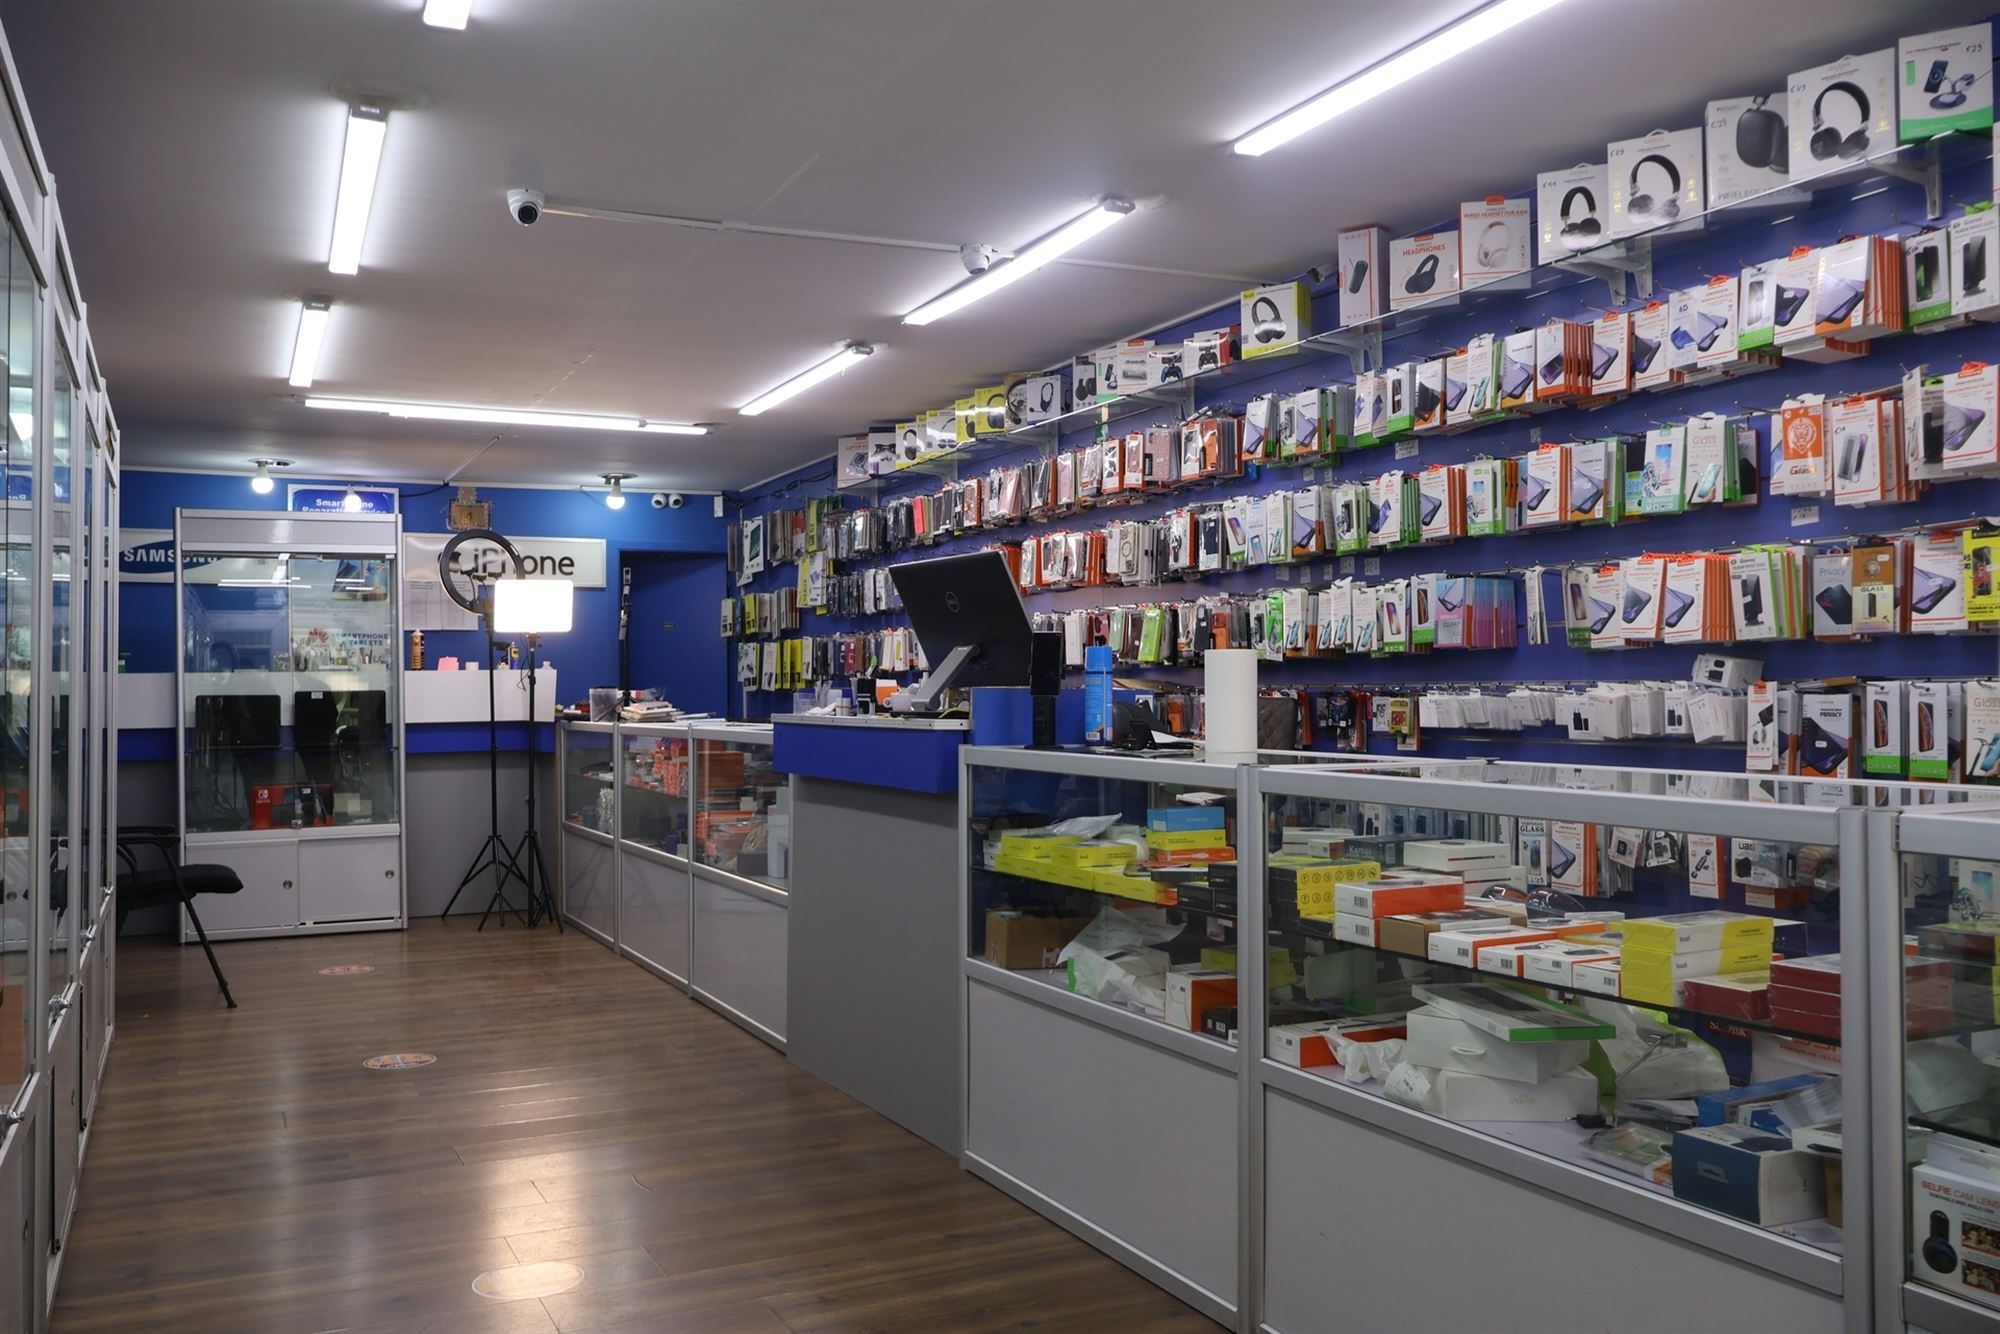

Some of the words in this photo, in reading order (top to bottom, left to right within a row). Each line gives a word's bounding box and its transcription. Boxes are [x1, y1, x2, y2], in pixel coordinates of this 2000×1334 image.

[1402, 244, 1446, 257] HEADPHONES
[1820, 567, 1846, 577] Privacy
[1520, 825, 1545, 833] GLASS
[1953, 1189, 1974, 1201] CAM
